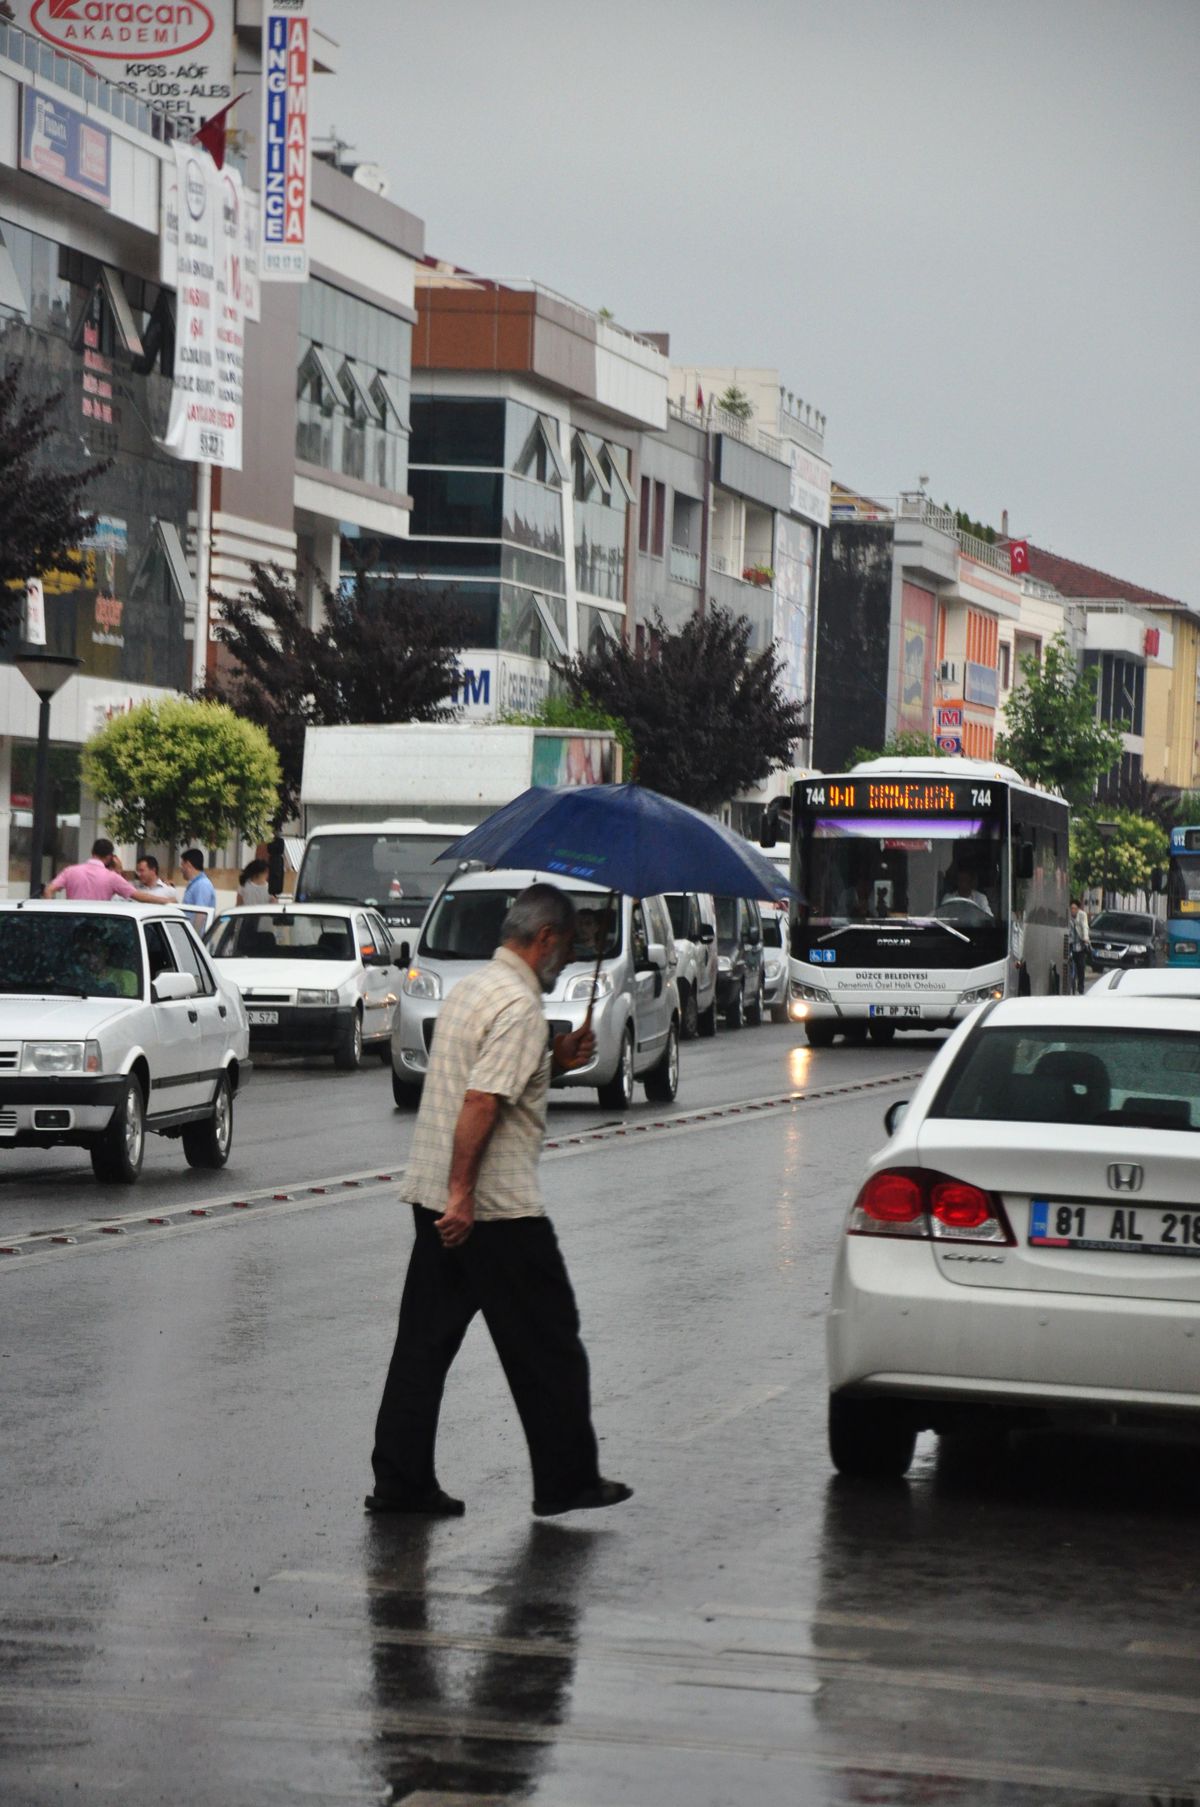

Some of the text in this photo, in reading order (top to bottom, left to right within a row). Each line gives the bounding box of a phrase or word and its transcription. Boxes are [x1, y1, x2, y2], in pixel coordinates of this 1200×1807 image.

[286, 21, 306, 241] ALMANCA
[806, 787, 826, 805] 744
[970, 789, 992, 807] 744
[856, 971, 928, 981] DÜZCE BELEDİYESİ
[875, 980, 893, 989] Özel
[895, 981, 911, 989] Halk
[1056, 1206, 1086, 1237] 81
[1109, 1209, 1143, 1241] AL
